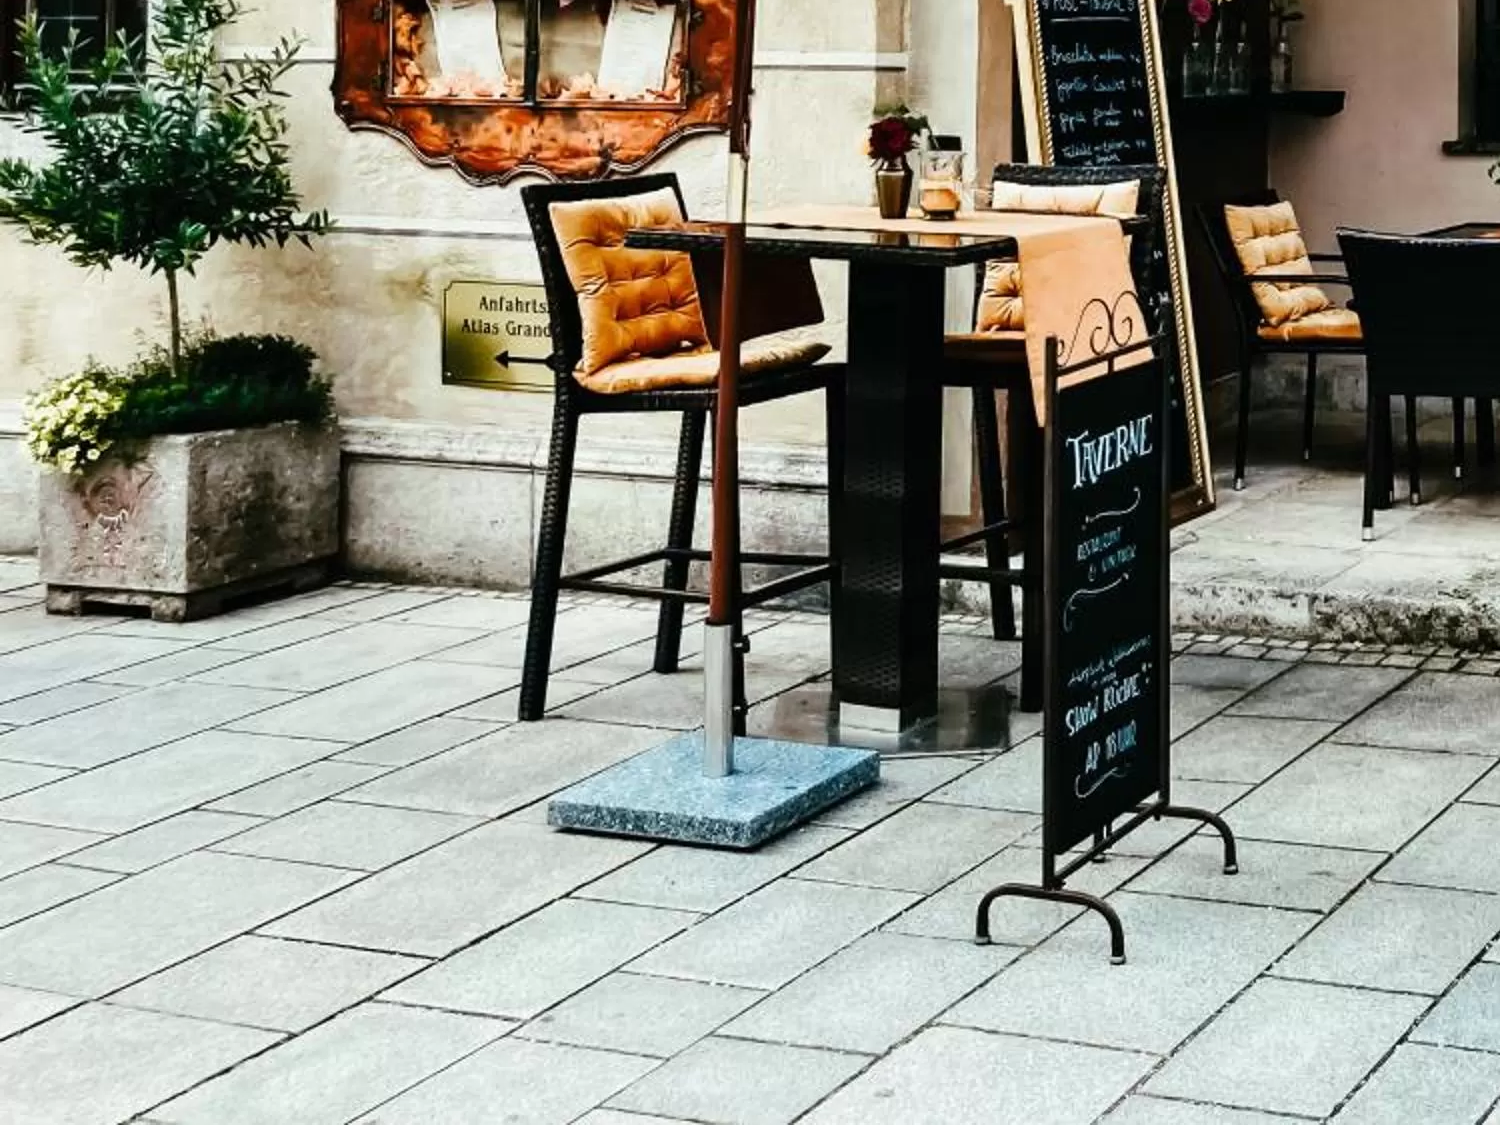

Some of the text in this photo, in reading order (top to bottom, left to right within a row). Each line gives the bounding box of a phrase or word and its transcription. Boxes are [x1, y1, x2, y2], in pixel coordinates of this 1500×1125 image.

[479, 295, 552, 314] Anfahrts
[461, 318, 499, 335] Atlas
[1065, 413, 1153, 490] TAVERNE
